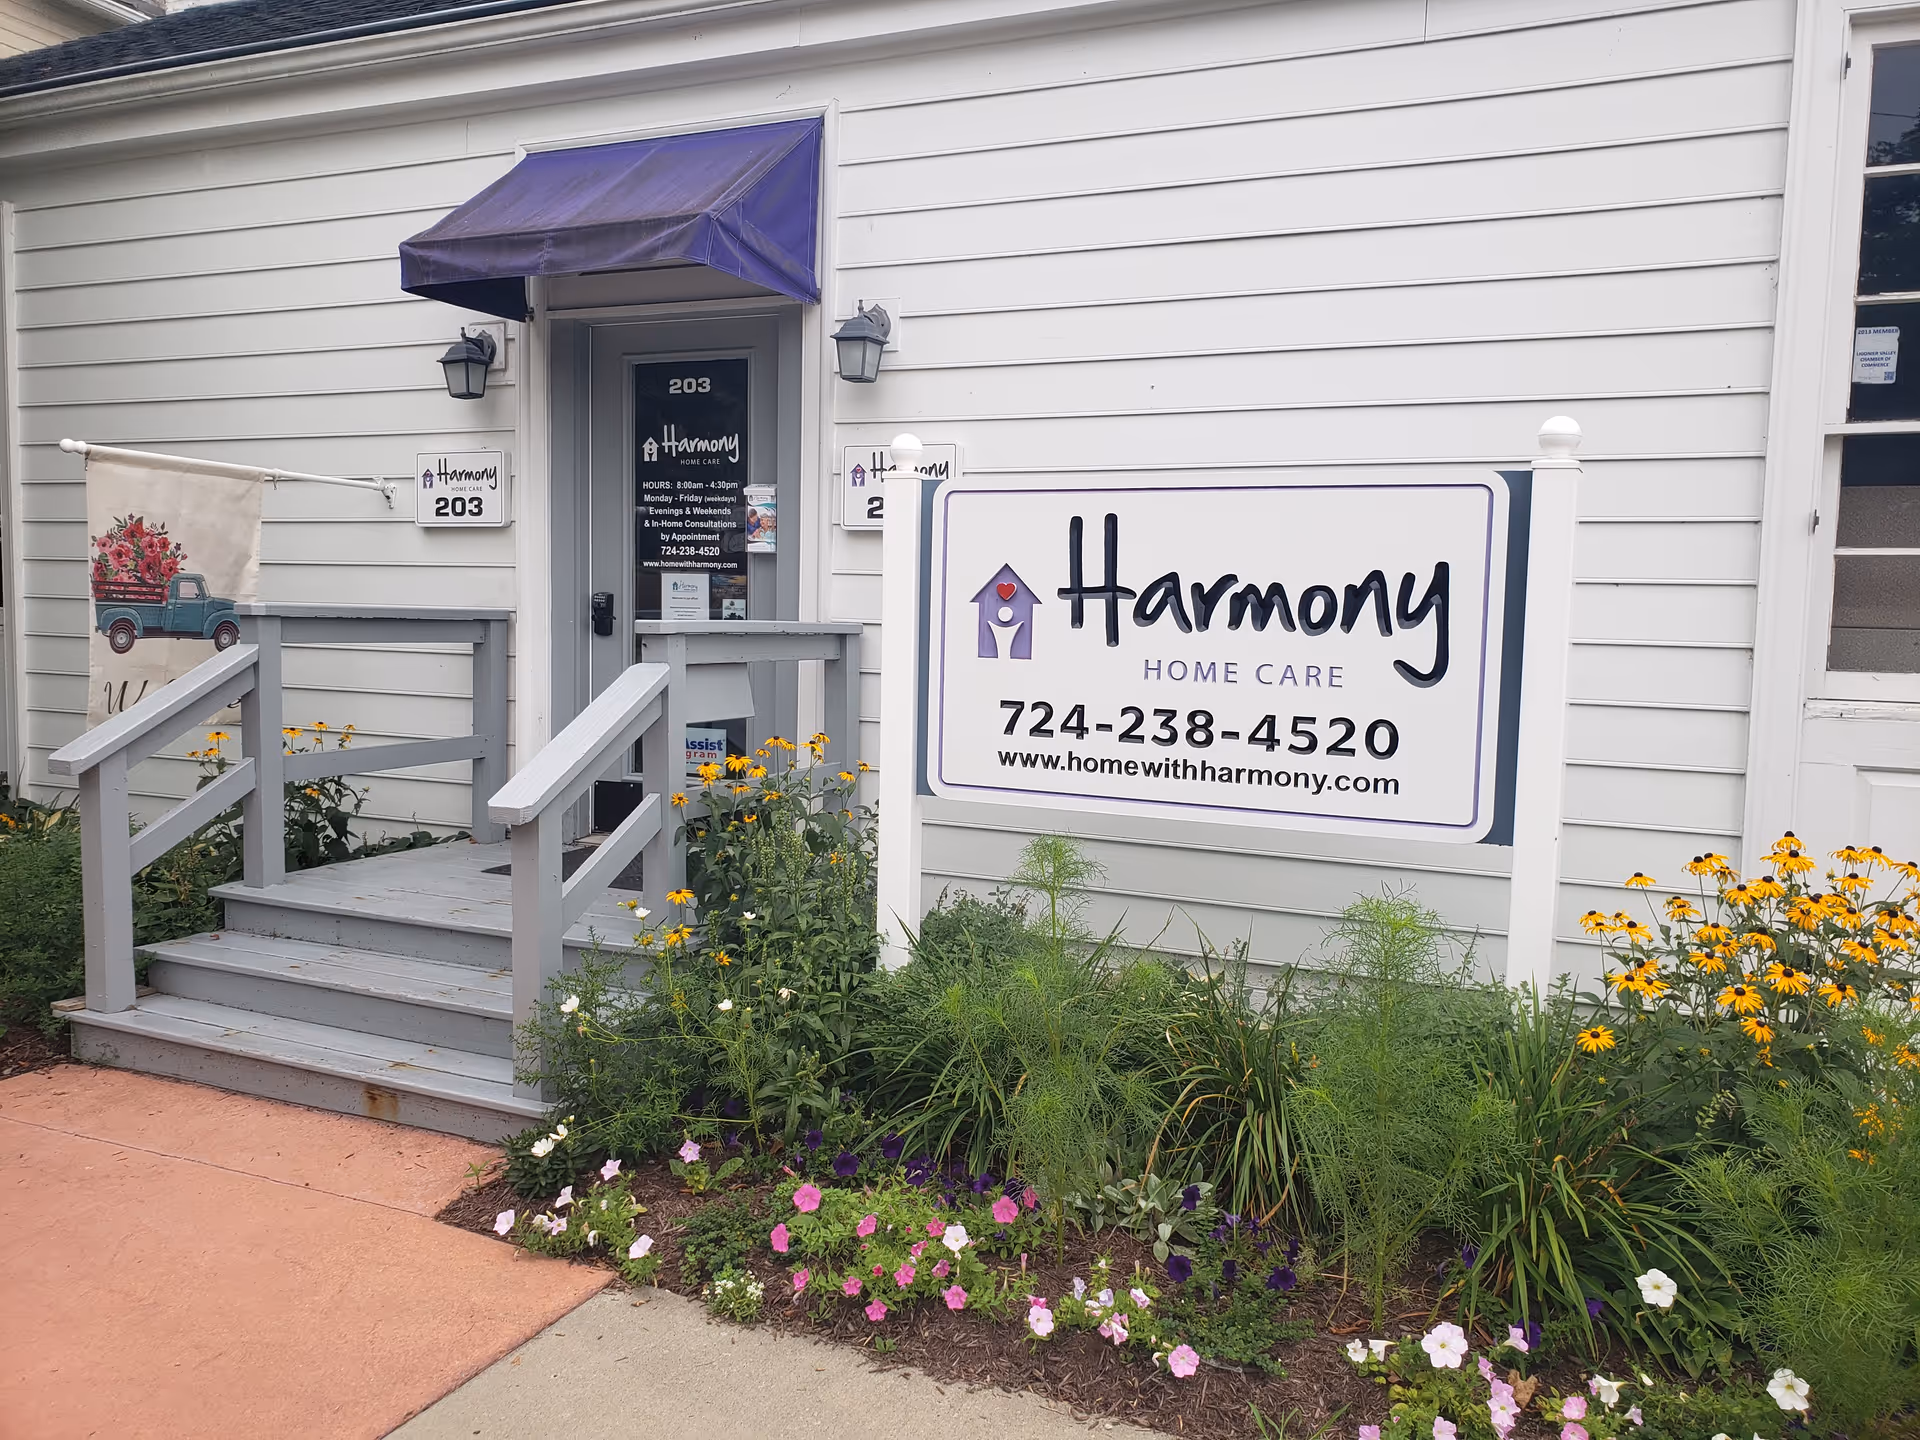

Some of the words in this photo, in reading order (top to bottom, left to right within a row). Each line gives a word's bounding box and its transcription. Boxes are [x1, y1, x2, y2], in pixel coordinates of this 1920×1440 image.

[668, 377, 711, 394] 203
[661, 423, 740, 463] Harmony
[680, 458, 701, 466] HOME
[436, 457, 498, 490] Harmony
[642, 481, 673, 490] HOURS:
[676, 481, 704, 490] 8:00am
[710, 480, 738, 491] 4:30pm
[643, 493, 673, 504] Monday
[679, 493, 703, 504] Friday
[704, 495, 737, 504] (weekdays)
[434, 496, 484, 517] 203
[649, 506, 683, 517] Evenings
[685, 506, 691, 515] &
[692, 506, 732, 515] Weekends
[643, 519, 650, 528] &
[651, 519, 683, 528] In-Home
[684, 519, 737, 528] Consultations
[660, 532, 669, 542] by
[671, 532, 720, 543] Appointment
[660, 546, 720, 556] 724-238-4520
[642, 560, 738, 570] www.homewithharmony.com
[1057, 512, 1450, 689] Harmony
[1143, 658, 1239, 685] HOME
[1255, 662, 1345, 689] CARE
[998, 699, 1400, 760] 724-238-4520
[997, 749, 1400, 796] www.homewithharmony.com
